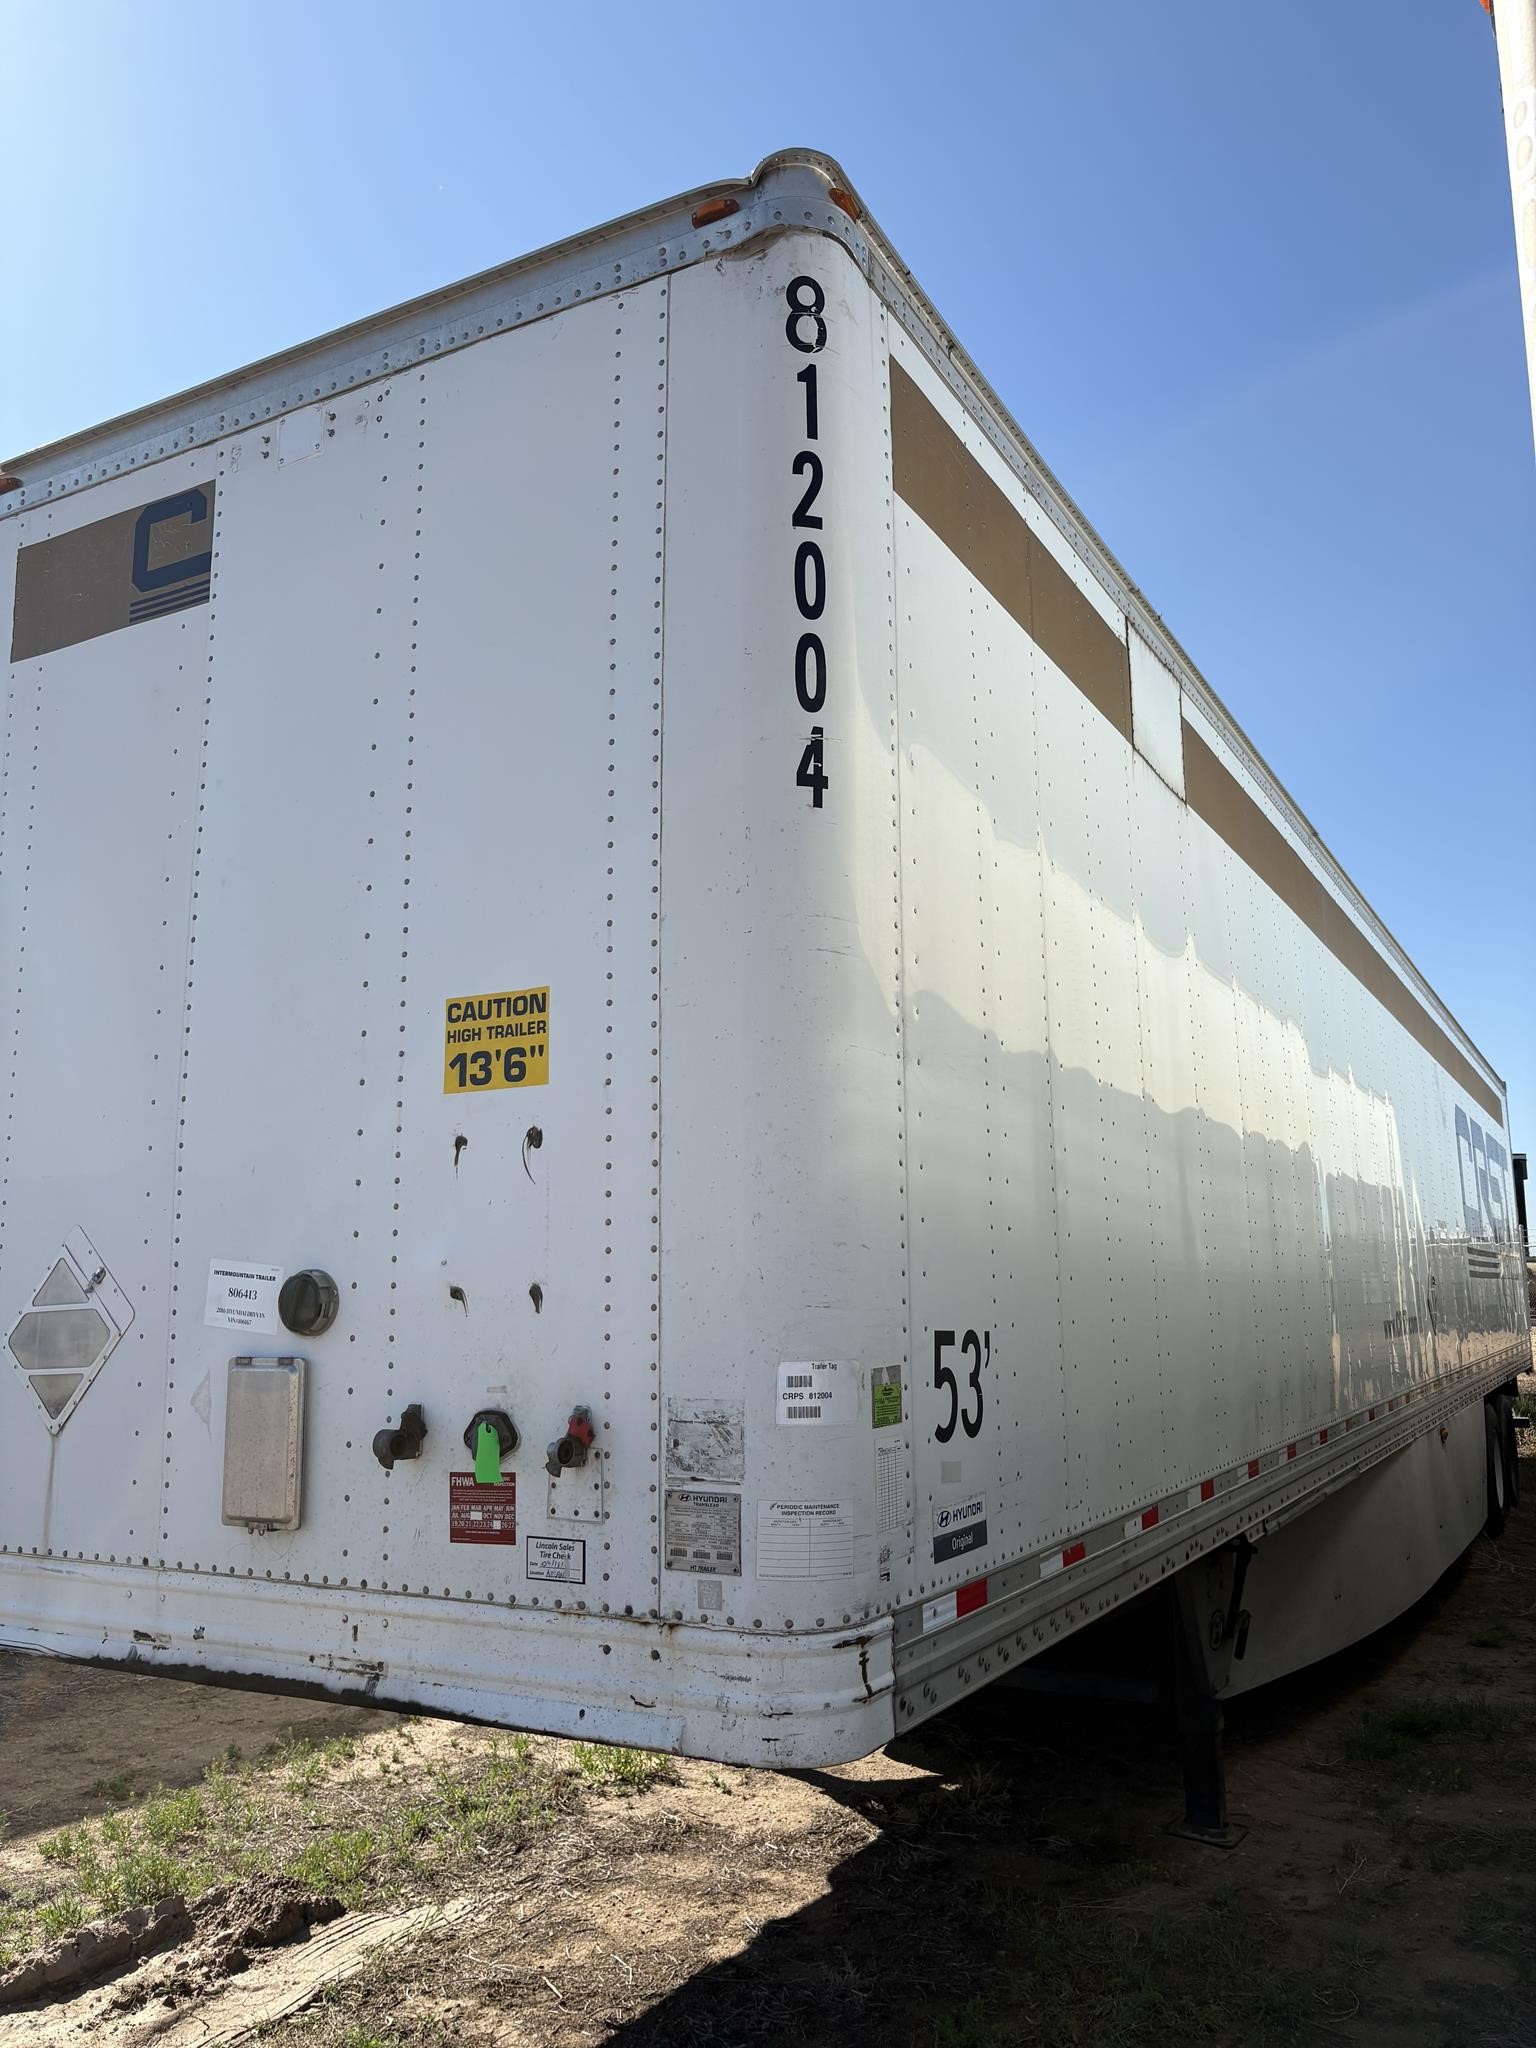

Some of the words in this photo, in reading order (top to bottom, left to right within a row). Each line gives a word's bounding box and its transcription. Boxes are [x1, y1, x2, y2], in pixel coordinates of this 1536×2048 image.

[785, 275, 829, 809] 812004
[447, 992, 547, 1023] CAUTION
[447, 1027, 482, 1044] HIGH
[486, 1019, 547, 1040] TRAILER
[448, 1044, 545, 1088] 13'6"
[213, 1269, 255, 1279] INTERMOUNTAIN
[255, 1274, 276, 1282] TRAILER
[228, 1287, 258, 1300] 806413
[828, 1363, 837, 1371] Tag
[782, 1392, 804, 1400] CRPS
[808, 1391, 833, 1400] 812004
[451, 1476, 475, 1487] FHWA
[692, 1495, 728, 1503] HYUNDAI
[953, 1501, 983, 1522] HYUNDAI
[535, 1541, 558, 1550] Lincoln
[558, 1543, 576, 1552] Sales
[951, 1531, 974, 1551] Original
[539, 1551, 552, 1559] Tire
